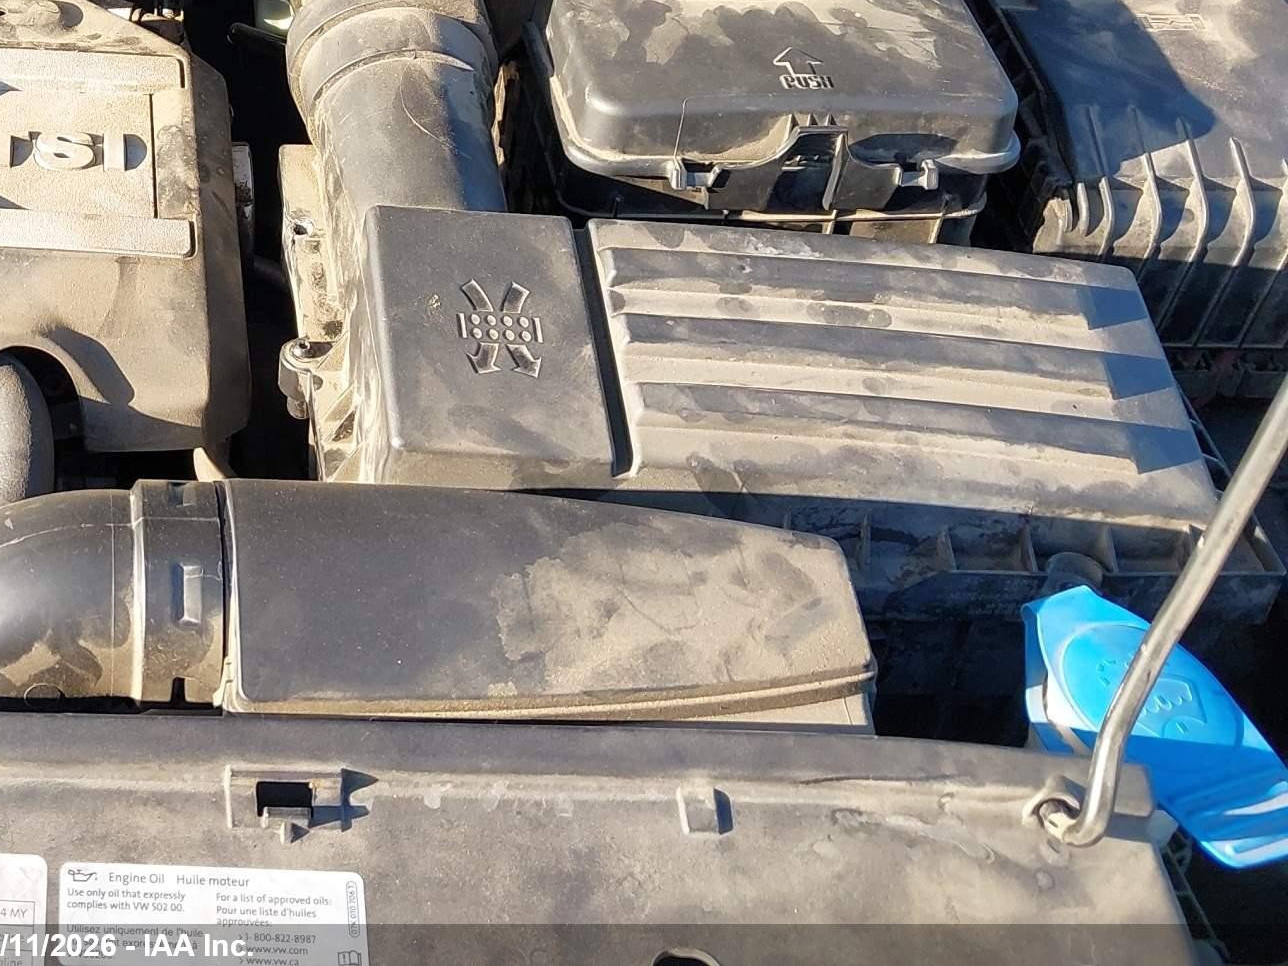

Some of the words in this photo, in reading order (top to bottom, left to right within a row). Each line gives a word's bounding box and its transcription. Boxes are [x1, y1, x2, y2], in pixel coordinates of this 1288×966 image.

[779, 74, 835, 89] PUSH
[108, 872, 147, 886] Engine
[149, 873, 165, 884] Oil
[176, 874, 206, 886] Huile
[208, 877, 251, 887] moteur
[67, 889, 84, 897] Use
[86, 889, 106, 900] only
[108, 889, 120, 898] oil
[122, 890, 141, 899] that
[143, 891, 186, 902] expressly
[216, 893, 231, 902] For
[240, 893, 254, 903] list
[256, 894, 266, 903] of
[268, 895, 311, 907] approved
[66, 900, 108, 911] complies
[110, 901, 131, 910] with
[132, 902, 149, 910] VW
[151, 902, 168, 912] 502
[216, 905, 236, 915] Pour
[239, 908, 257, 916] une
[259, 907, 279, 916] liste
[281, 907, 317, 918] d'huiles
[10, 907, 29, 919] MY
[66, 923, 101, 934] Utilisez
[103, 925, 159, 936] uniquement
[161, 927, 173, 936] de
[245, 932, 317, 944] 1-800-822-8987
[246, 946, 309, 956] www.vw.com
